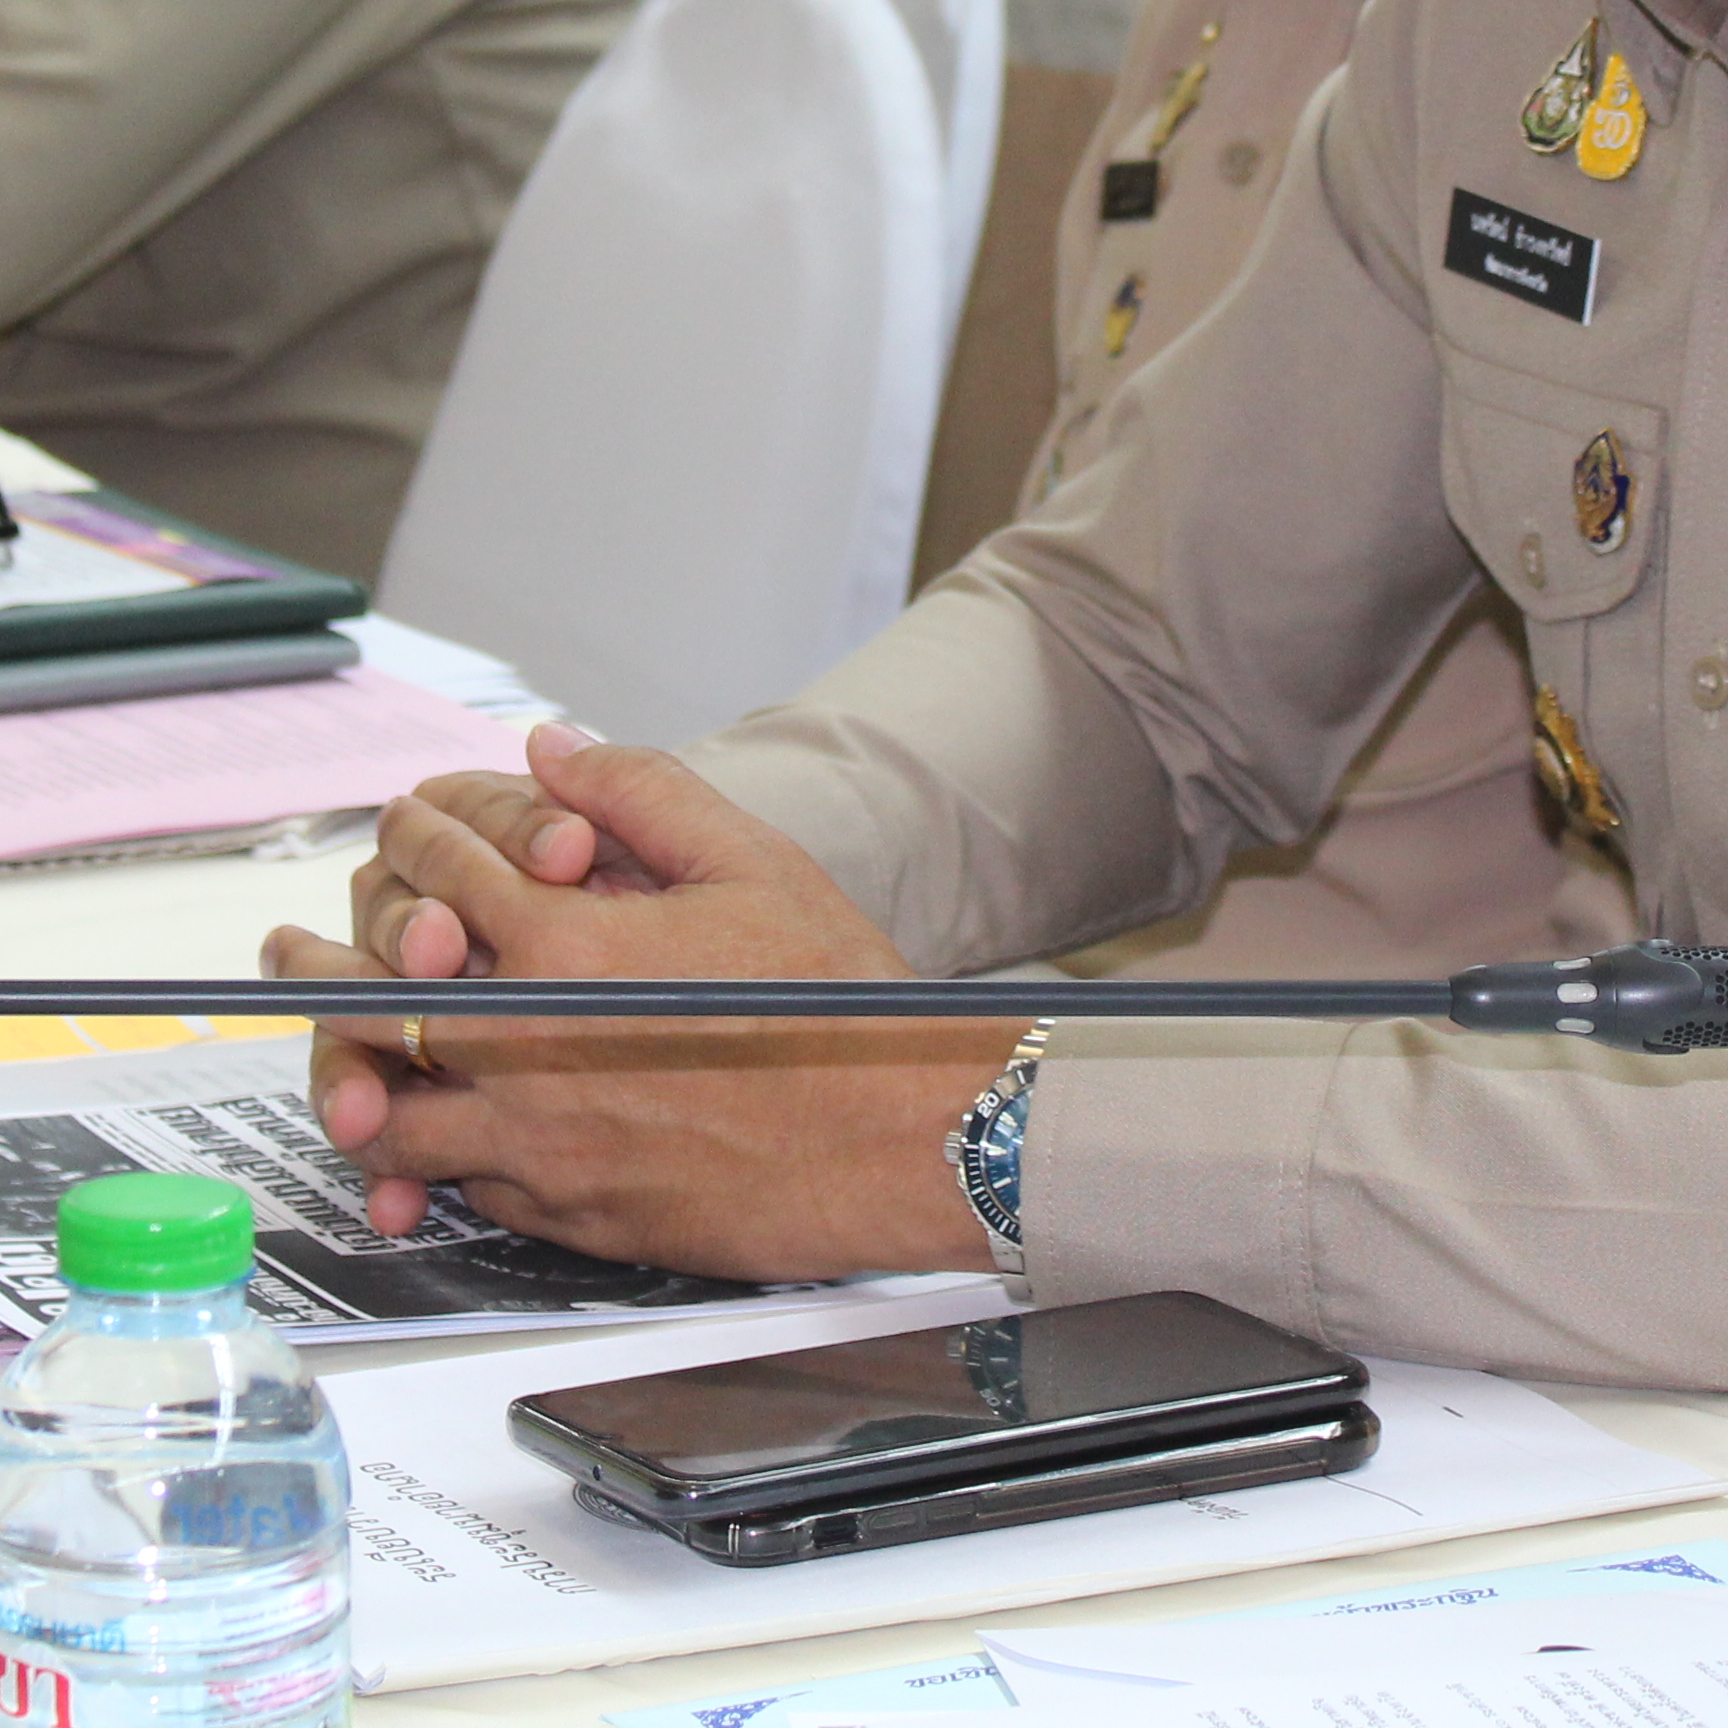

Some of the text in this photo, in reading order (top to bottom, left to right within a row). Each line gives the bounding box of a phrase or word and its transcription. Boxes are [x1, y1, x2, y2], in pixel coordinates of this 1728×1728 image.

[977, 1091, 1001, 1120] 20
[345, 1505, 456, 1583] ระเบียบวา
